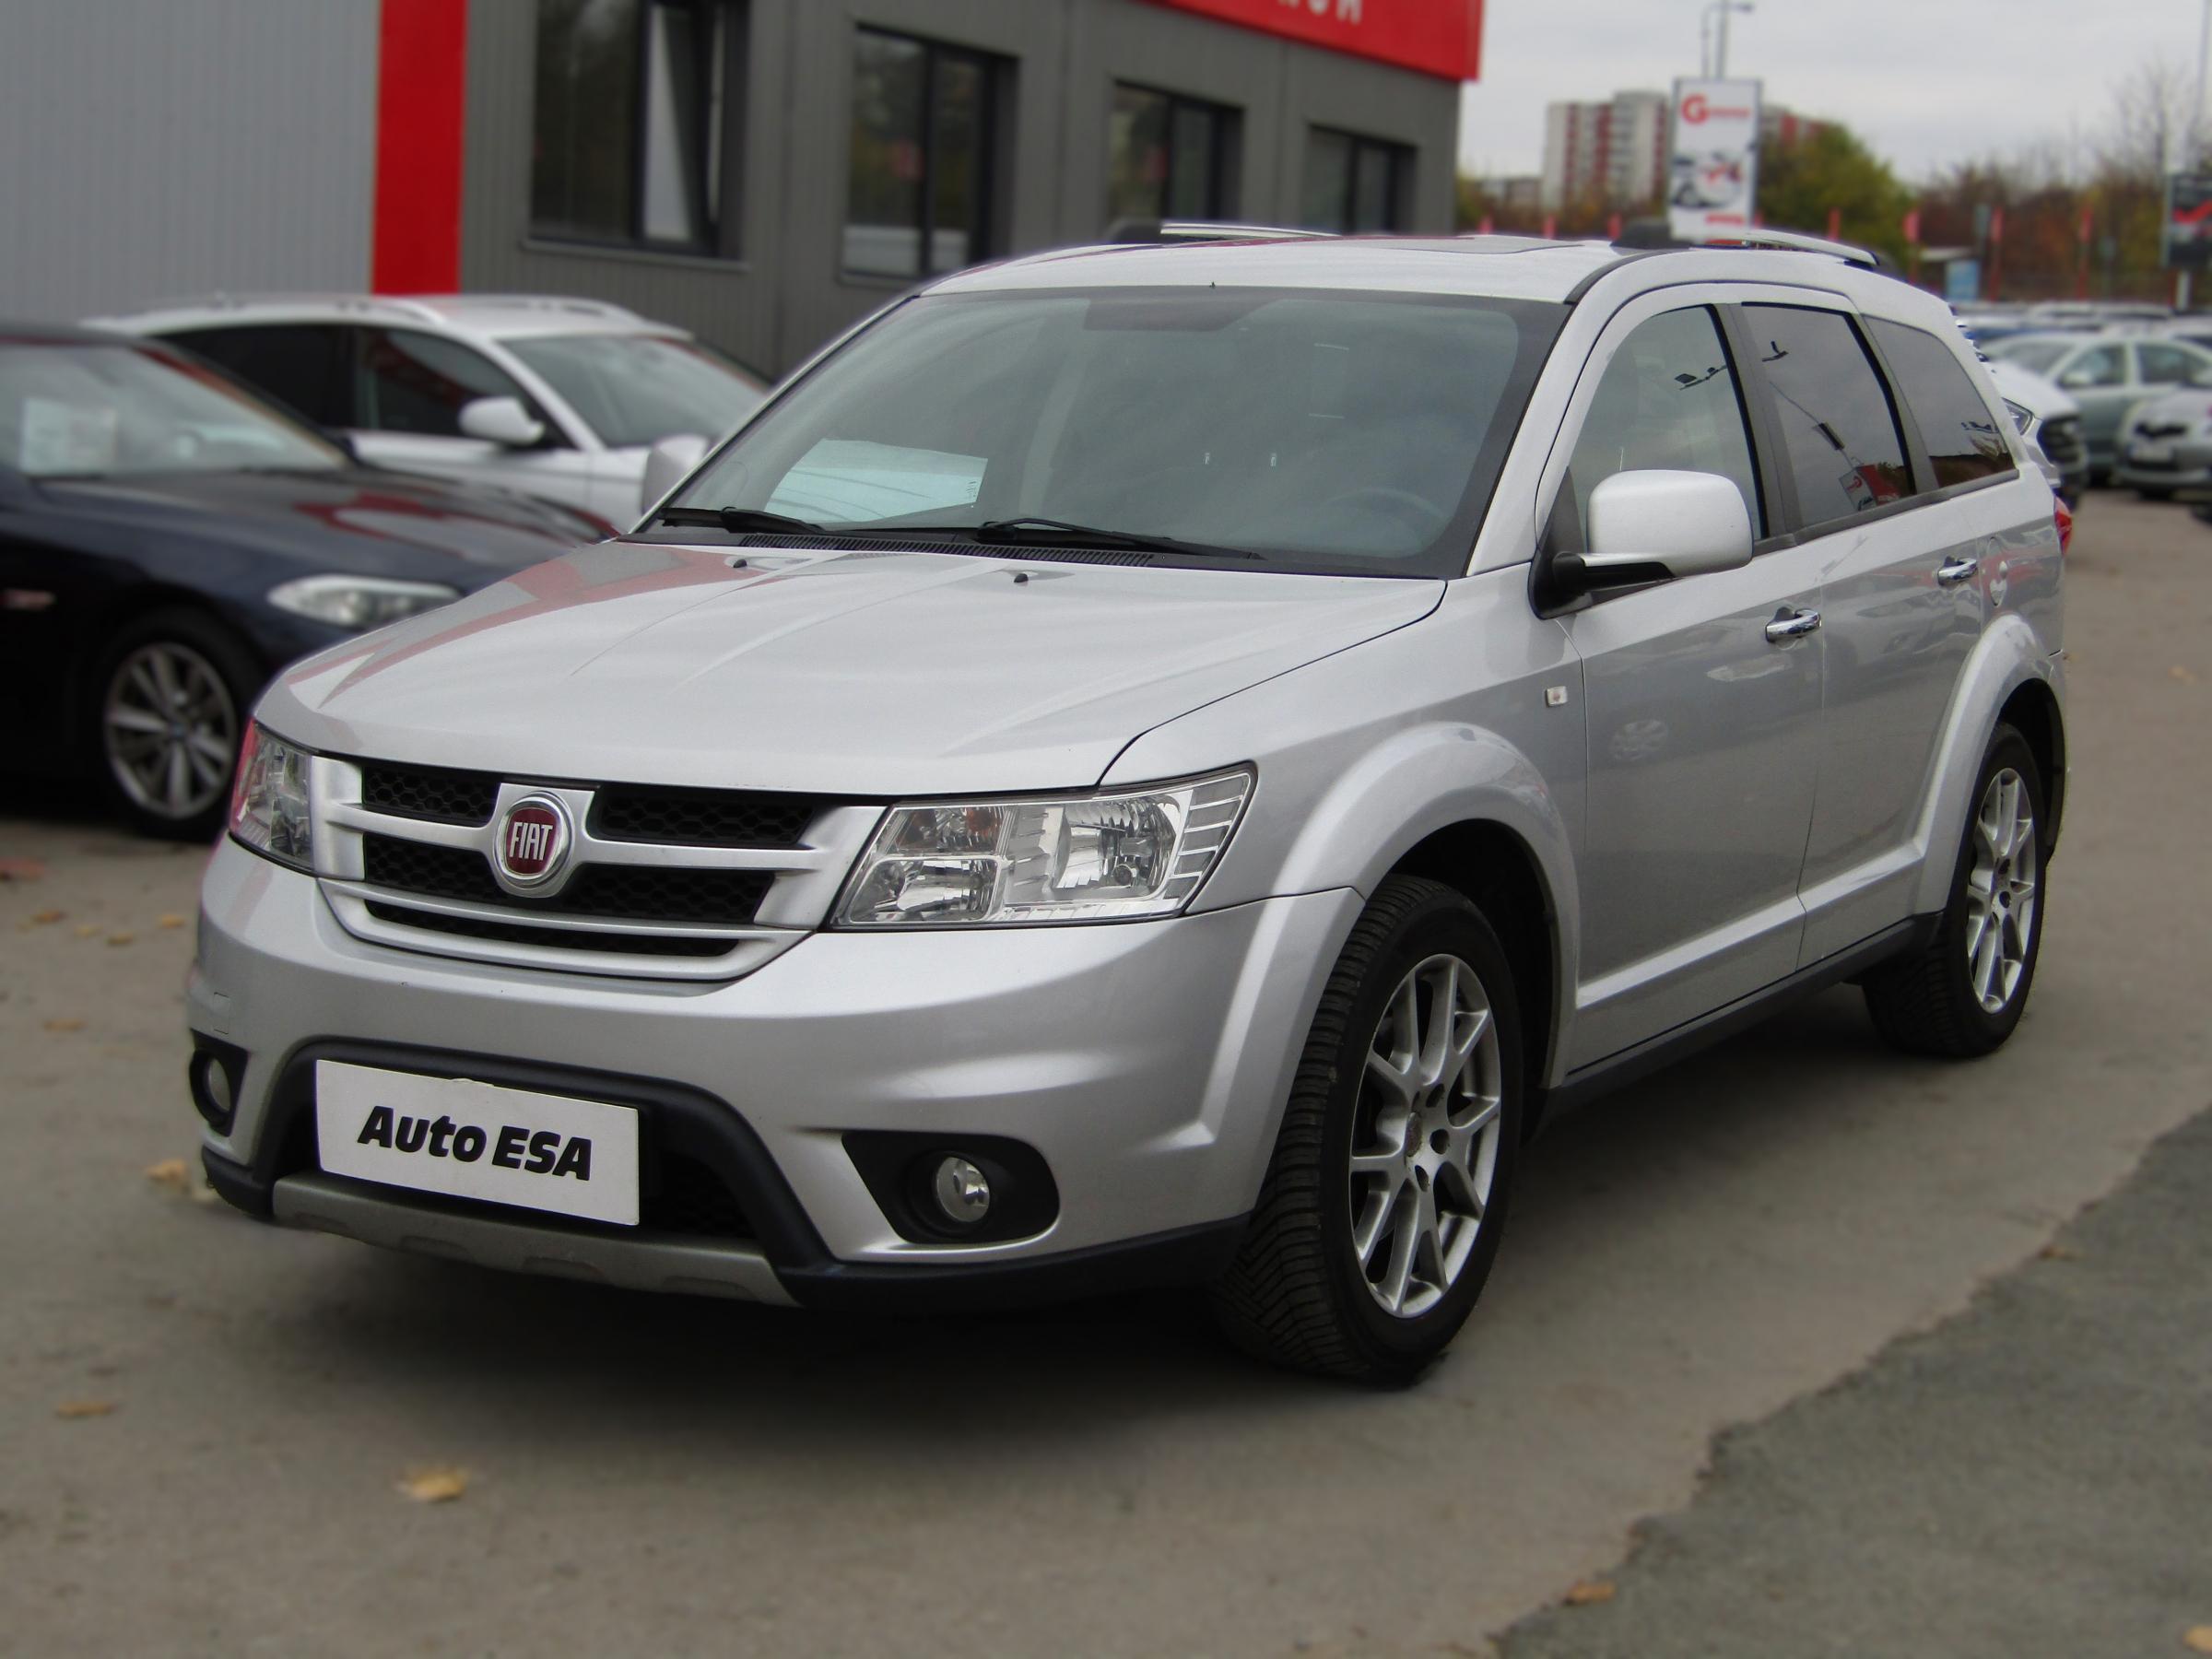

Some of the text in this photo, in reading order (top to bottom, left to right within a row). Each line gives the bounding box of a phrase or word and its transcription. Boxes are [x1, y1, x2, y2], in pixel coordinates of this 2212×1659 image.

[509, 821, 553, 861] FIAT
[357, 1105, 593, 1182] Auto ESA
